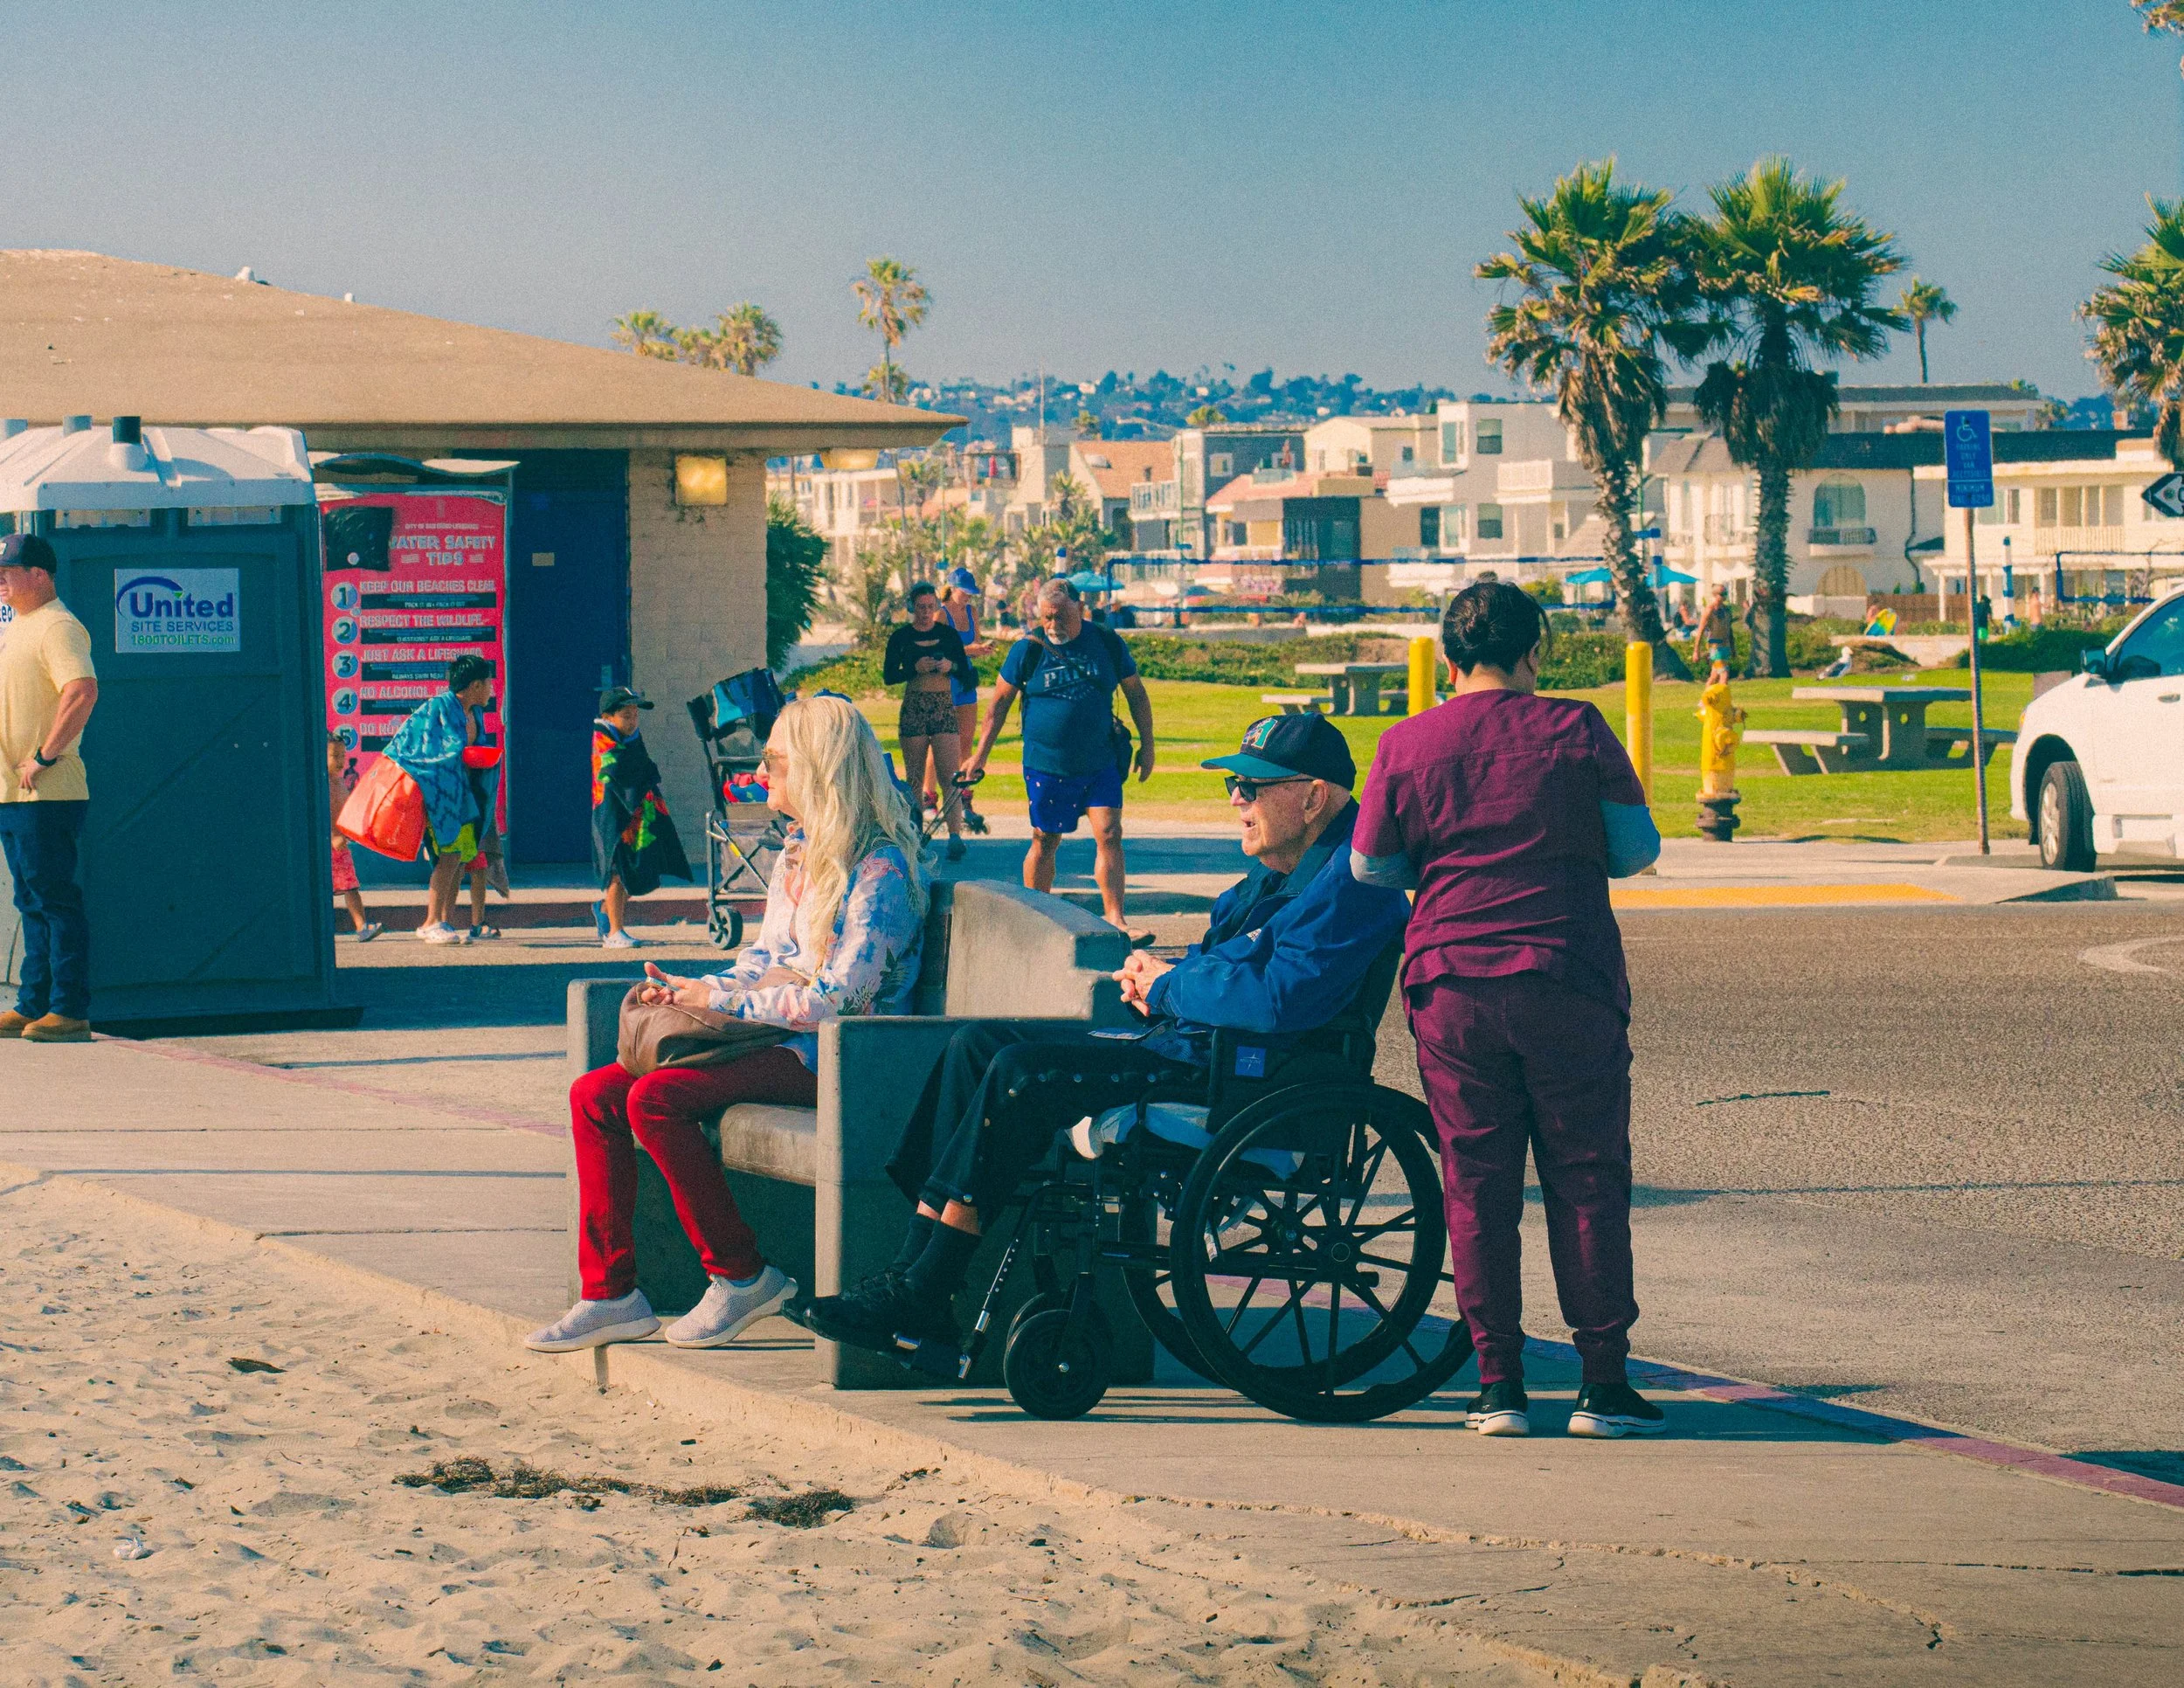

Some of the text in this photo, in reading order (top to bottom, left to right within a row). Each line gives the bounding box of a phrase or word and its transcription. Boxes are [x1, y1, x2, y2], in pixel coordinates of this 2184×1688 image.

[445, 535, 496, 550] SAFETY
[425, 551, 465, 567] TIPS
[360, 581, 388, 594] KEEP
[391, 580, 414, 593] OUR
[418, 579, 466, 592] BEACHES
[339, 587, 347, 605] 1
[130, 592, 234, 618] United
[132, 621, 234, 633] SITE SERVICES
[360, 615, 411, 628] RESPECT
[414, 614, 434, 627] THE
[338, 622, 350, 640] 2
[132, 634, 236, 647] 1800TOILETS.com
[361, 650, 389, 662] JUST
[392, 649, 415, 661] ASK
[418, 649, 426, 661] A
[338, 655, 351, 674] 3
[360, 688, 377, 698] NO
[337, 693, 351, 711] 4
[360, 723, 376, 735] DO
